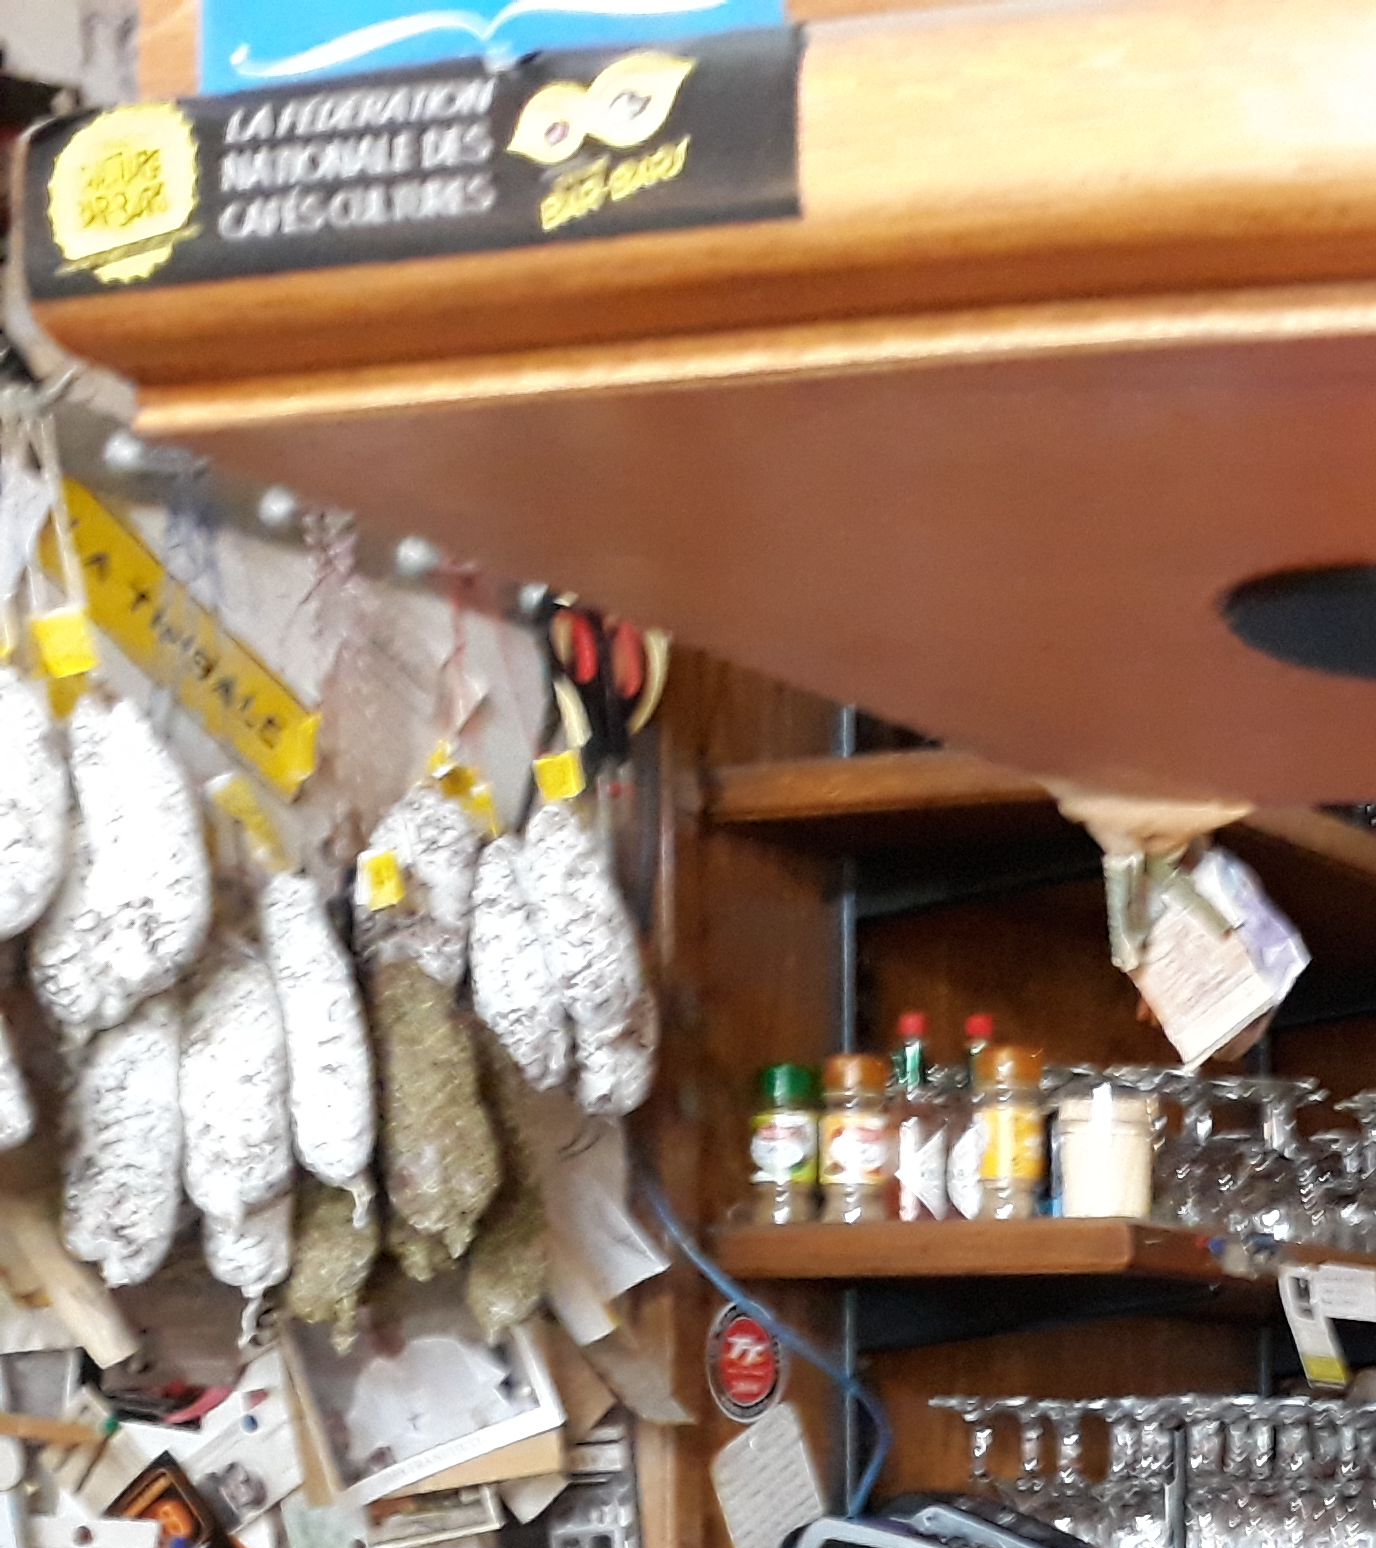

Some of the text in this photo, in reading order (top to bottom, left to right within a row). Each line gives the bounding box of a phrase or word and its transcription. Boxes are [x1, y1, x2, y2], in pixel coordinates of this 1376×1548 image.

[225, 104, 276, 144] LA
[220, 132, 420, 191] NATIONALE
[421, 121, 495, 168] DES
[330, 174, 496, 227] CULTURES
